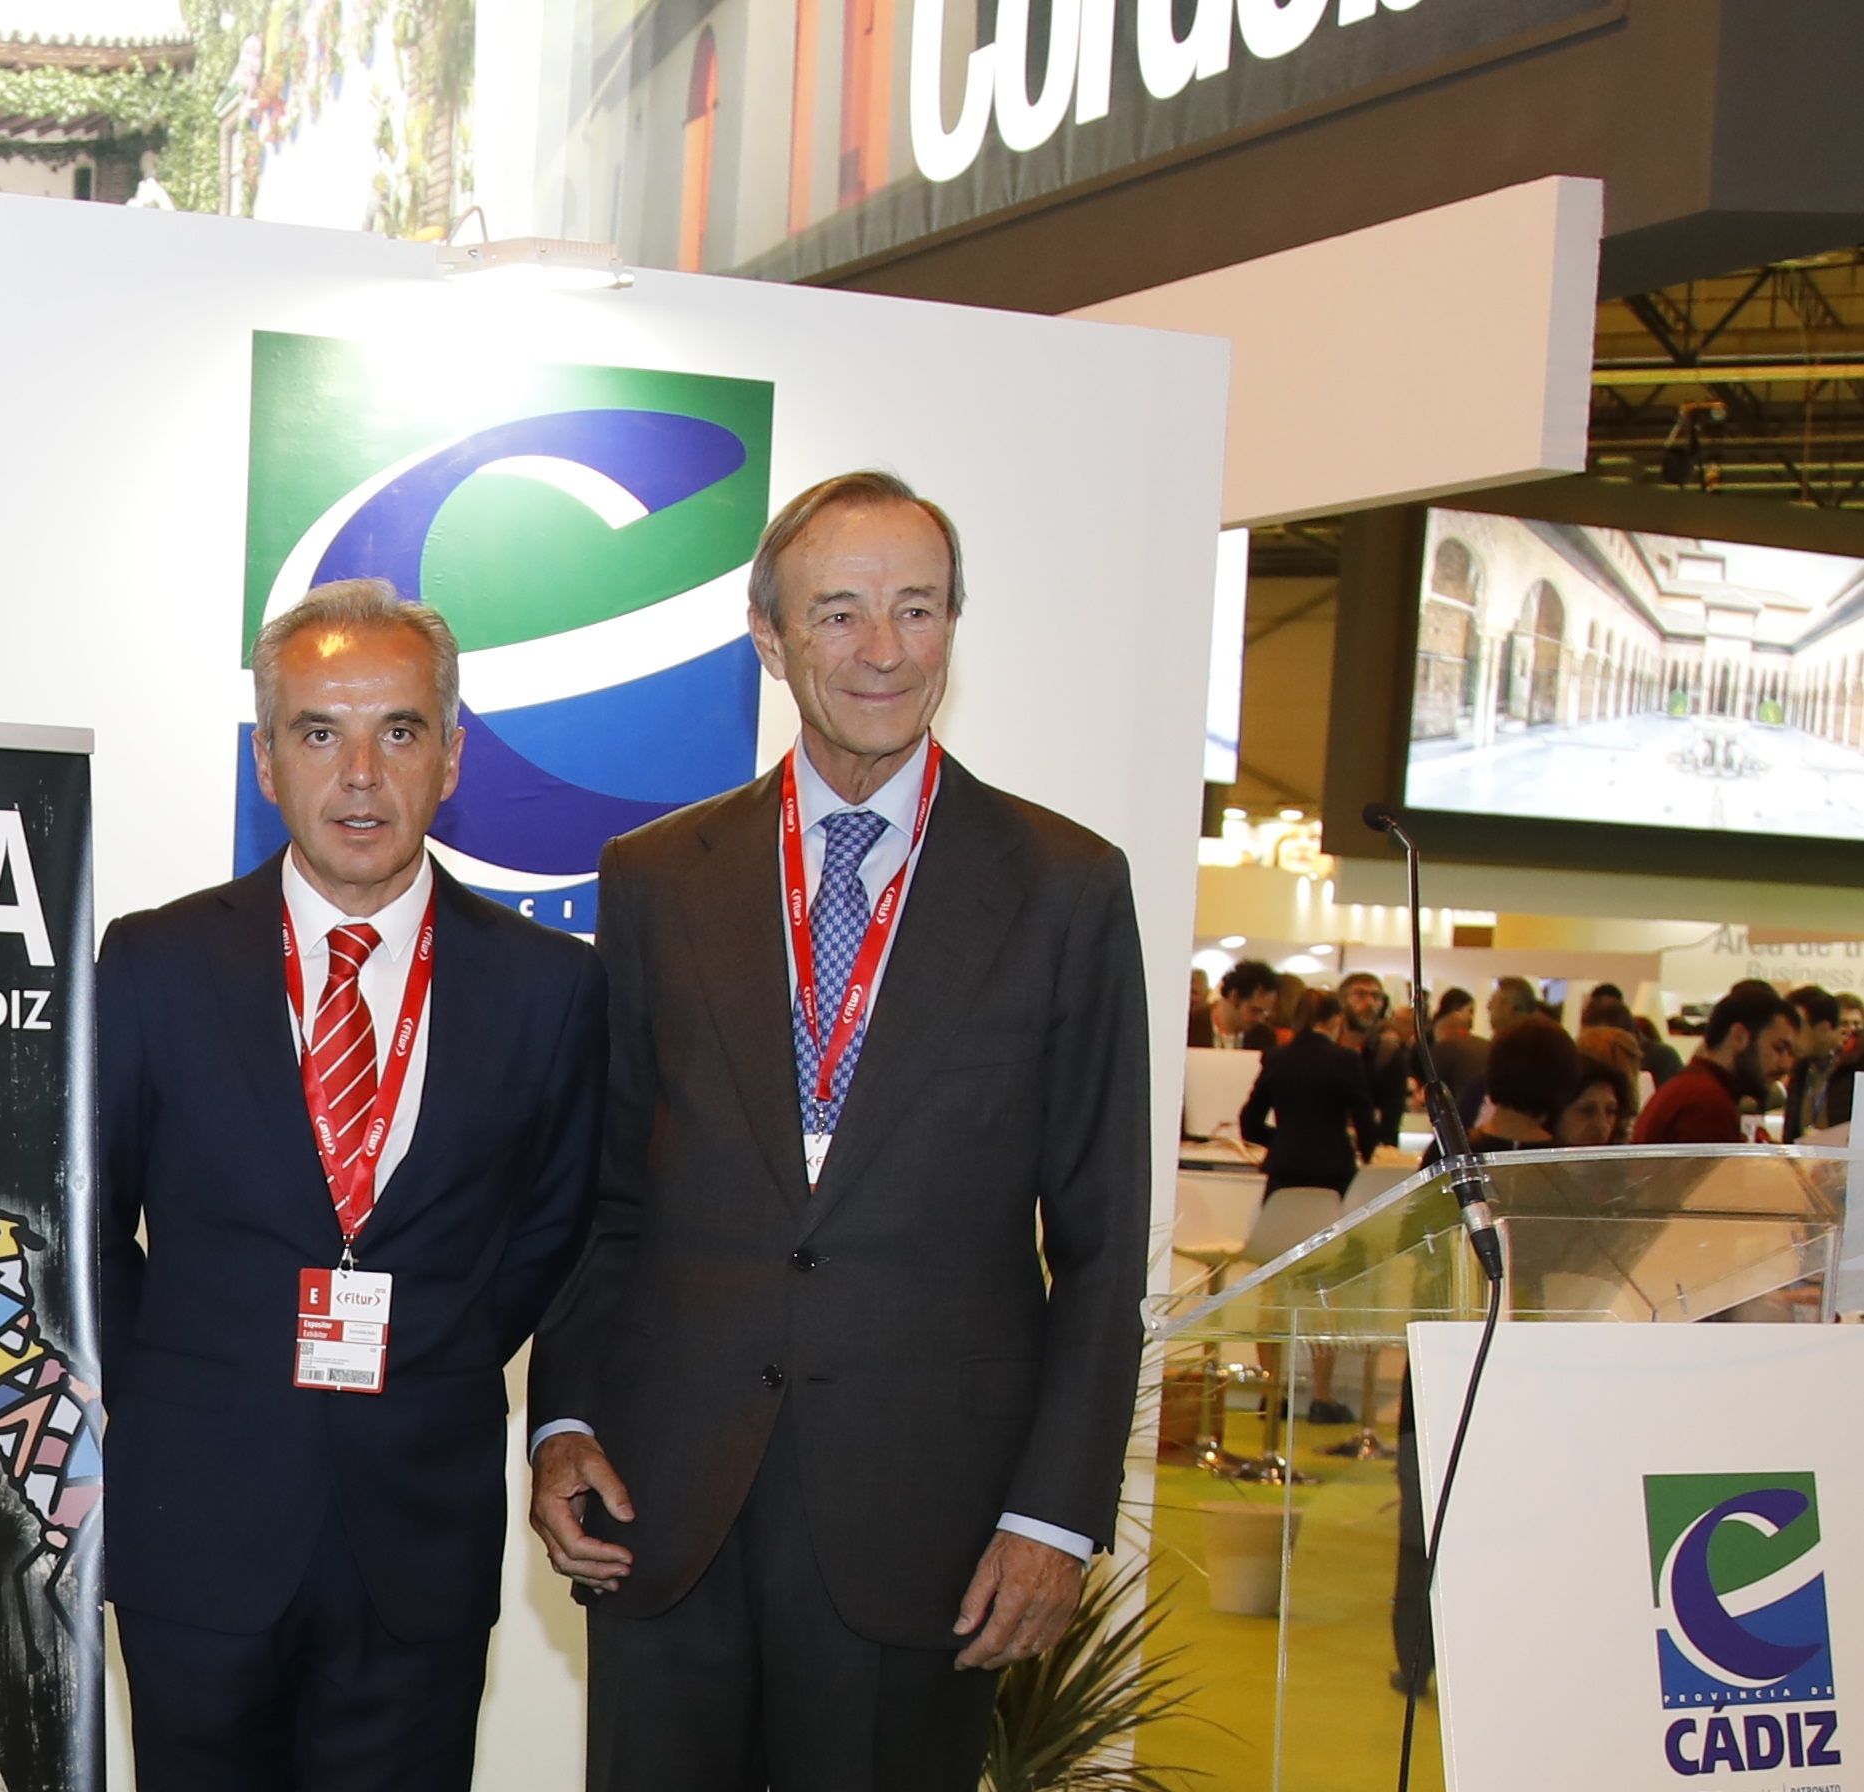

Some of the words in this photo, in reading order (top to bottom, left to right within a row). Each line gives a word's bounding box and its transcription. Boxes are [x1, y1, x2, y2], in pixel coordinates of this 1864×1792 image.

[841, 988, 864, 1023] Fitur
[310, 1287, 320, 1305] E
[1664, 1688, 1791, 1703] PROVINCIA
[1811, 1686, 1833, 1696] DE
[1664, 1702, 1842, 1777] CÁDIZ
